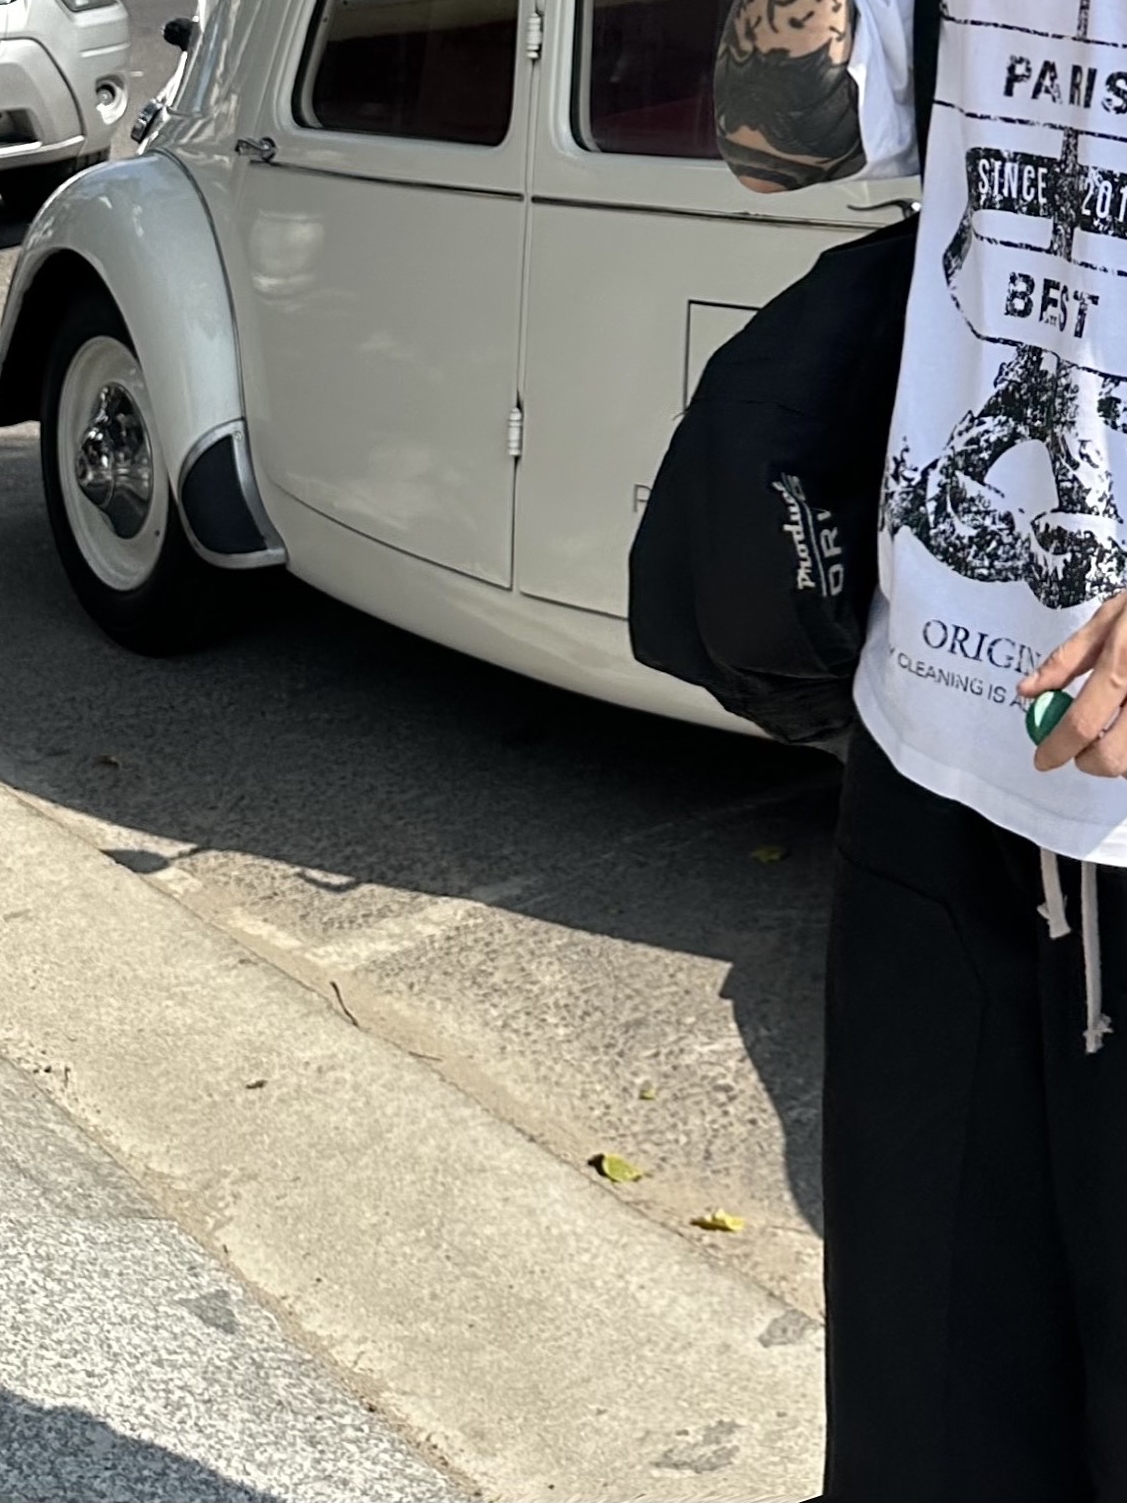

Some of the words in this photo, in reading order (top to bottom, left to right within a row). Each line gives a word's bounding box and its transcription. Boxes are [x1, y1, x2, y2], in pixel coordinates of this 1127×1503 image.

[978, 158, 1049, 204] SINCE
[1005, 271, 1099, 339] BEST
[897, 651, 984, 696] CLEANING
[988, 684, 1008, 704] IS
